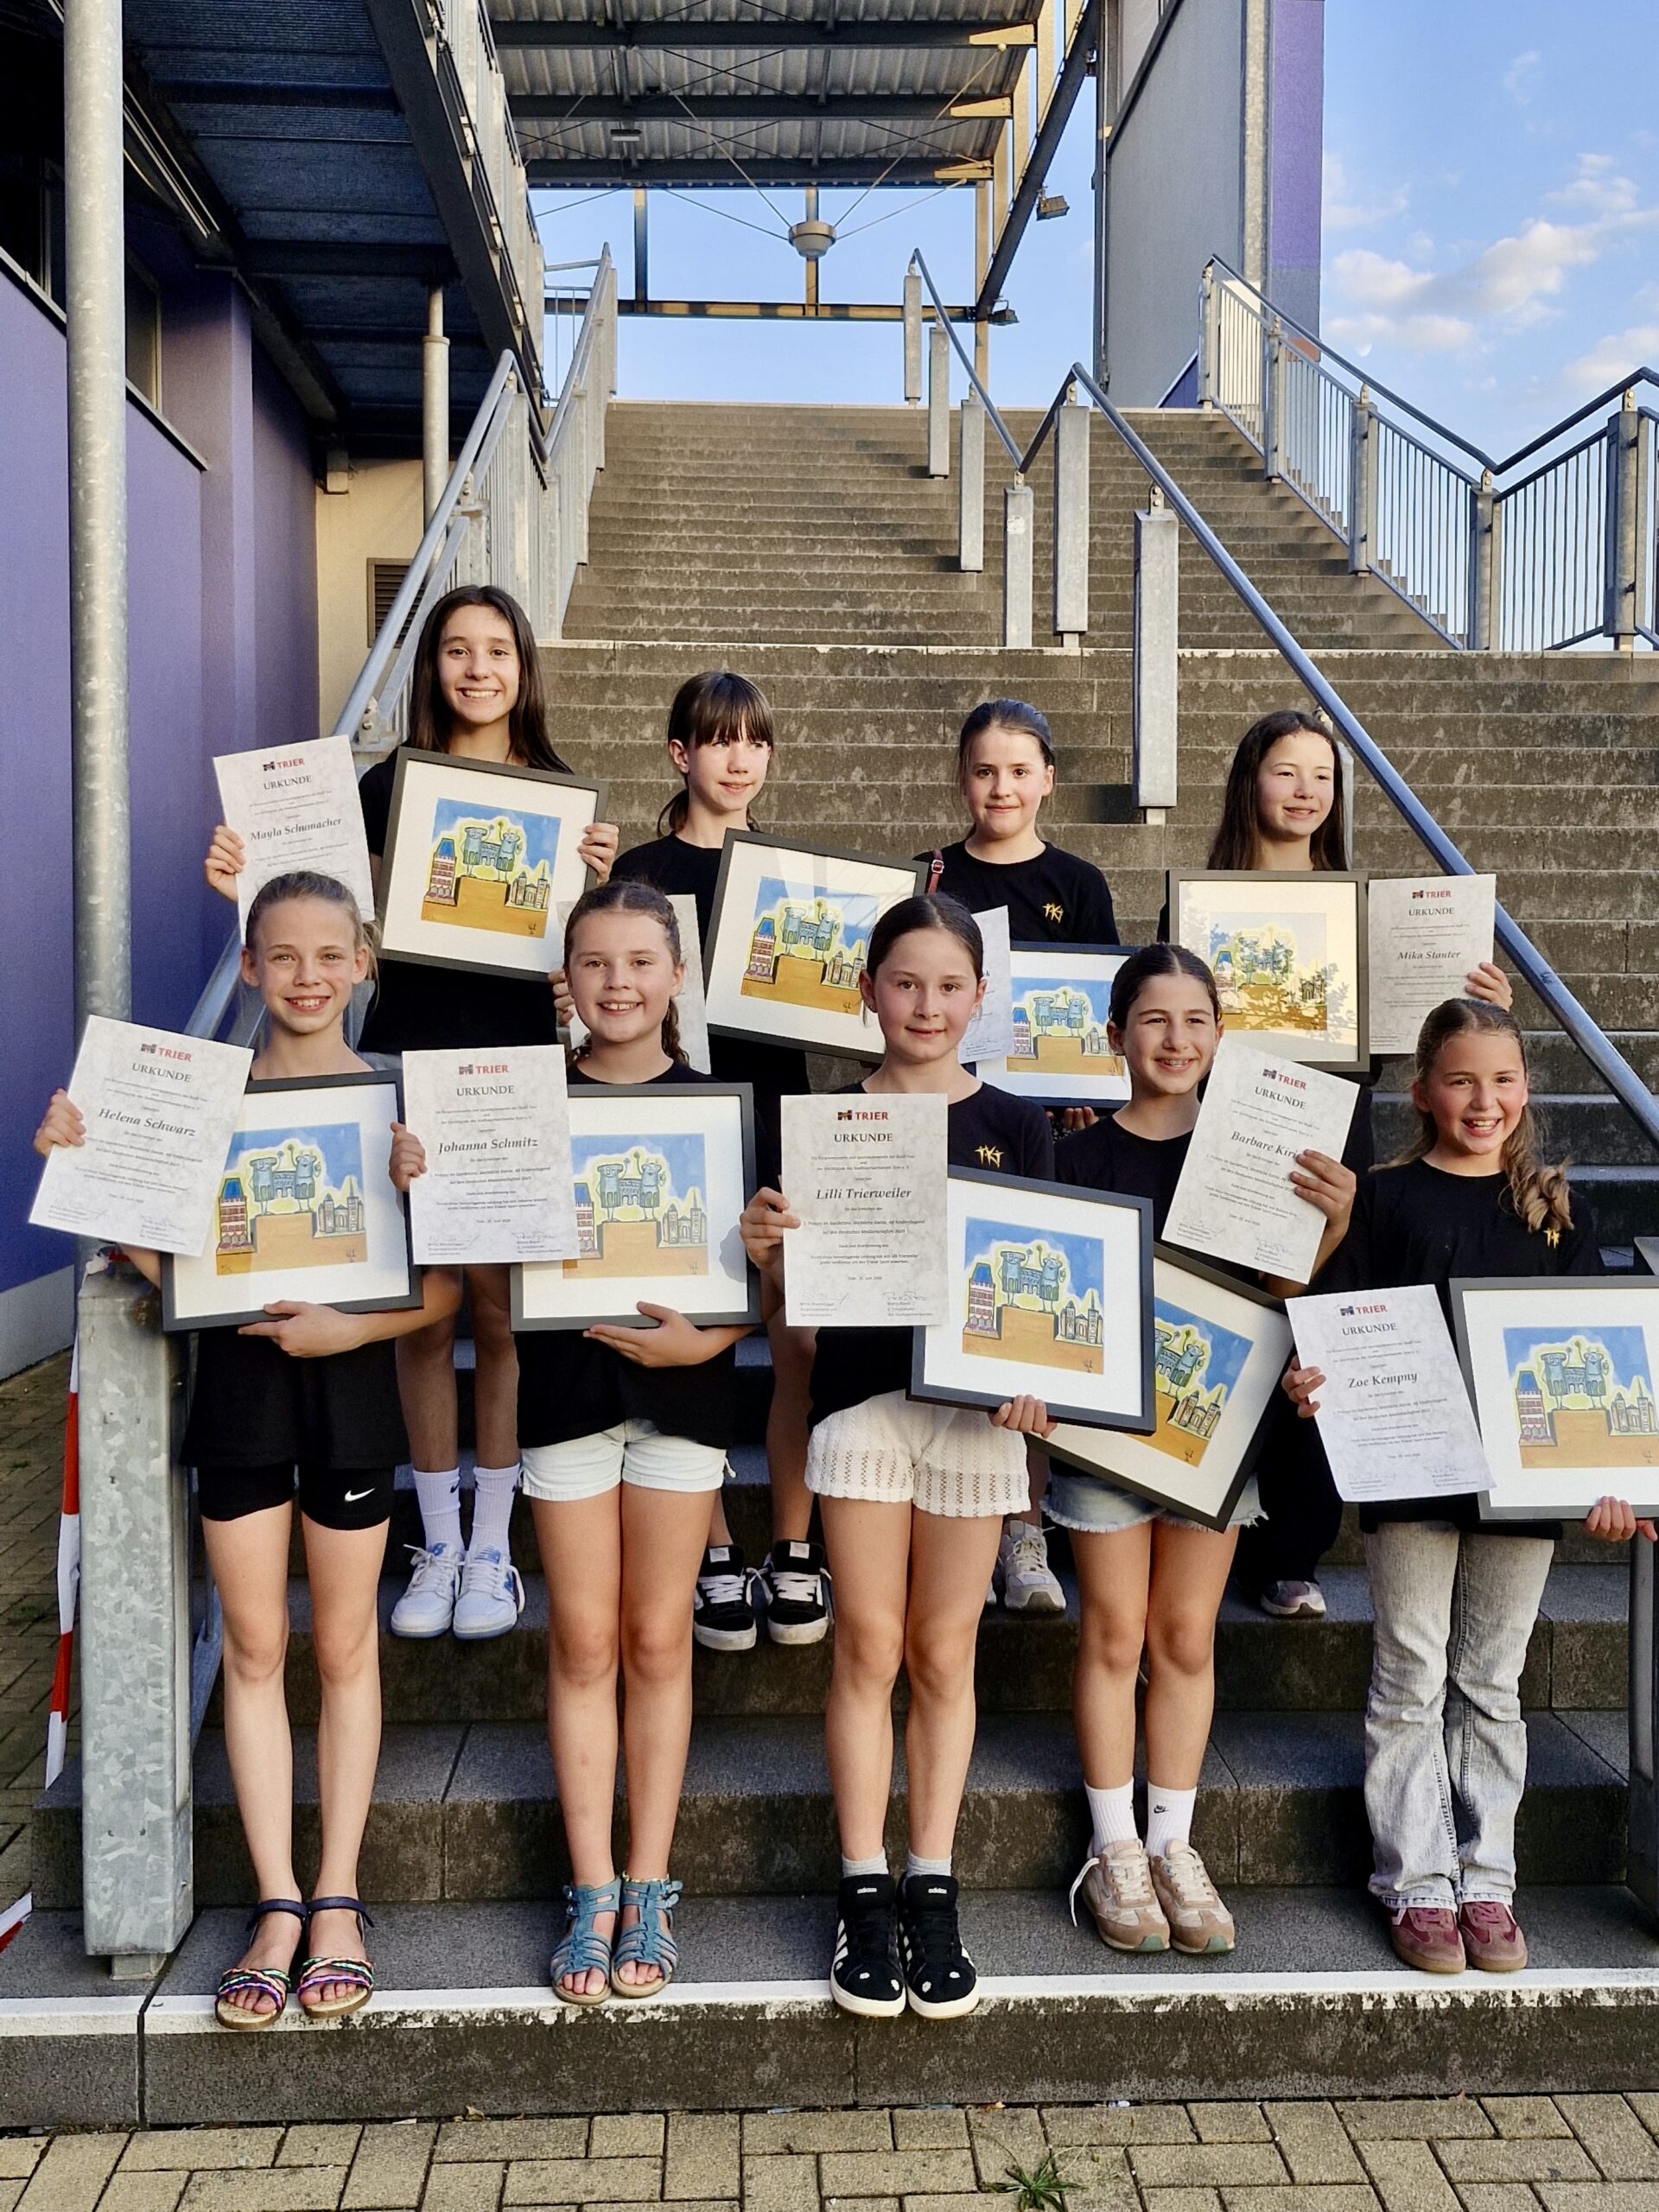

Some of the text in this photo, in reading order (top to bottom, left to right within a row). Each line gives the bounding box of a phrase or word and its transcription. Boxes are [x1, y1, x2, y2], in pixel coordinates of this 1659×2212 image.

[276, 758, 305, 770] TRIER
[264, 775, 312, 791] URKUNDE
[251, 817, 342, 841] Mayla Schumacher
[1426, 890, 1452, 899] TRIER
[1408, 907, 1455, 917] URKUNDE
[1397, 950, 1423, 960] Mika
[158, 1047, 192, 1062] TRIER
[131, 1062, 192, 1084] URKUNDE
[476, 1065, 509, 1075] TRIER
[1277, 1074, 1307, 1090] TRIER
[456, 1084, 515, 1096] URKUNDE
[1255, 1086, 1306, 1110] URKUNDE
[98, 1108, 196, 1138] Helena Schwarz
[855, 1111, 888, 1121] TRIER
[438, 1136, 539, 1154] Johanna Schmitz
[834, 1133, 893, 1143] URKUNDE
[1230, 1130, 1274, 1152] Barbare
[816, 1187, 912, 1199] Lilli Trierweiler
[1355, 1305, 1388, 1314] TRIER
[1342, 1322, 1397, 1336] URKUNDE
[1348, 1371, 1419, 1389] Zoe Kempny
